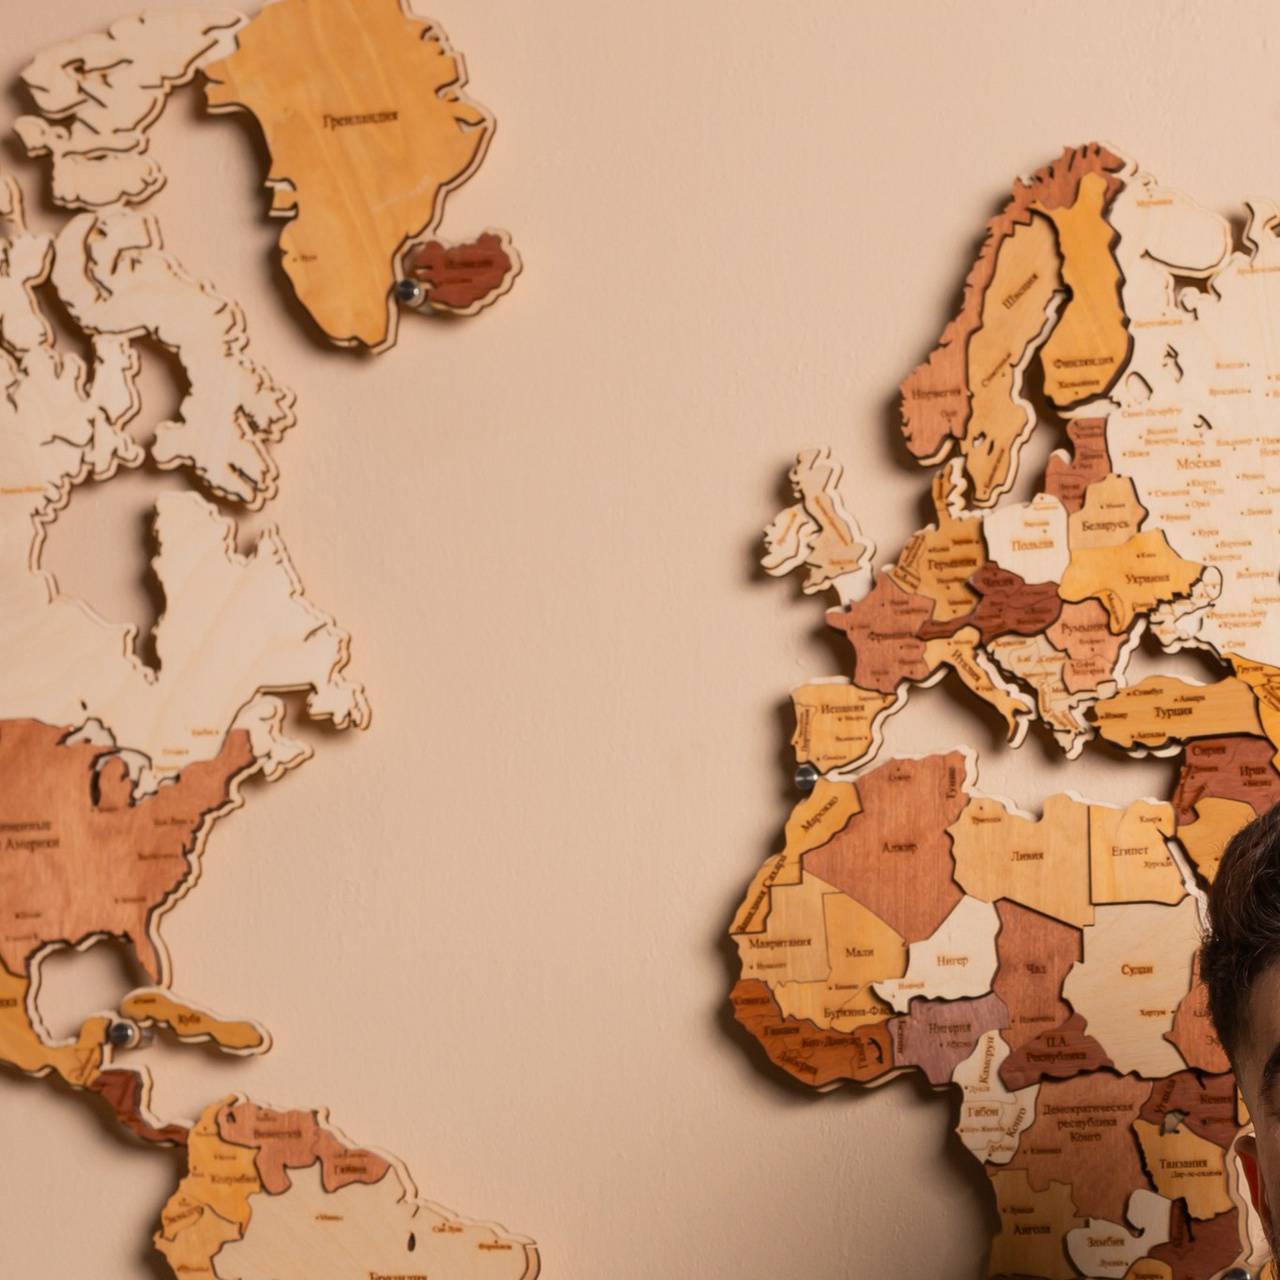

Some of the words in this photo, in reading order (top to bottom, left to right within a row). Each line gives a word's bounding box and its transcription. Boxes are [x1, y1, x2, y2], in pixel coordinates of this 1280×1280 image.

[1002, 274, 1038, 310] Швеция
[912, 388, 961, 401] Норвегия
[1177, 458, 1221, 471] Москва
[1082, 520, 1130, 533] Беларусь
[1012, 540, 1054, 552] Польша
[1125, 573, 1169, 586] Украина
[951, 649, 981, 682] Италия
[822, 704, 864, 716] Испания
[1154, 705, 1193, 719] Турция
[1192, 745, 1227, 758] Сирия
[1240, 764, 1266, 779] Ирак
[801, 797, 838, 833] Марокко
[882, 842, 918, 855] Алжир
[1112, 846, 1148, 858] Египет
[1011, 851, 1044, 863] Ливия
[764, 854, 787, 887] Сахара
[750, 938, 811, 952] Мавритания
[846, 947, 874, 959] Мали
[937, 955, 968, 969] Нигер
[1026, 963, 1046, 975] Чад
[1121, 964, 1153, 976] Судан
[929, 1022, 971, 1037] Нигерия
[980, 1035, 995, 1084] Камерун
[1027, 1051, 1087, 1063] Республика
[967, 1106, 999, 1118] Габон
[1043, 1104, 1133, 1116] Демократическая
[1008, 1107, 1027, 1139] Конго
[1058, 1118, 1117, 1130] республика
[1070, 1132, 1102, 1144] Конго
[1160, 1158, 1208, 1170] Танзания
[1014, 1223, 1051, 1236] Ангола
[1088, 1236, 1124, 1249] Замбия
